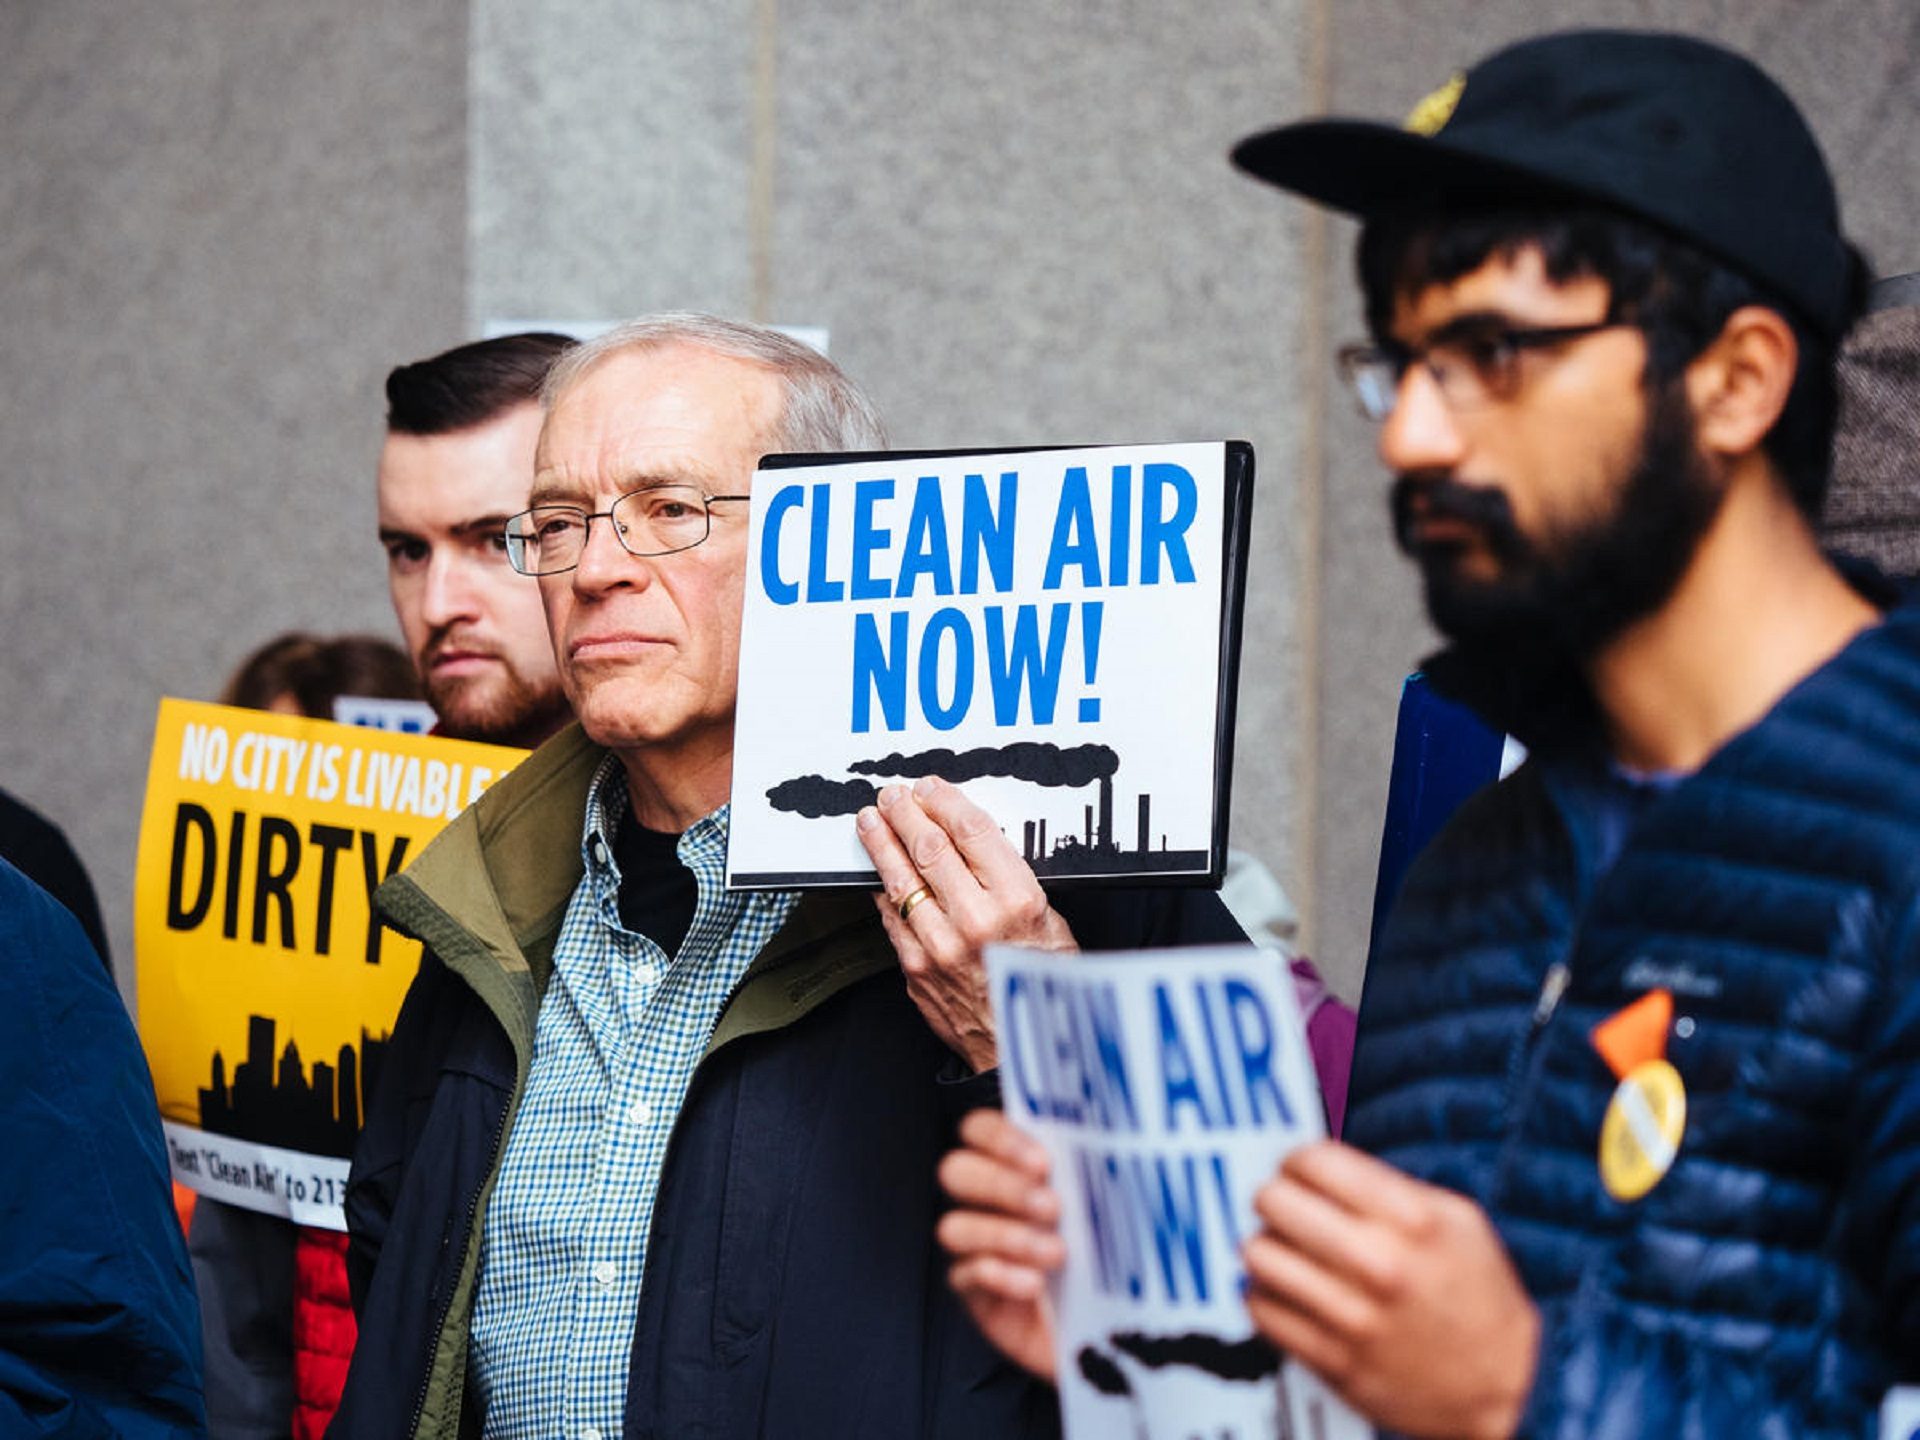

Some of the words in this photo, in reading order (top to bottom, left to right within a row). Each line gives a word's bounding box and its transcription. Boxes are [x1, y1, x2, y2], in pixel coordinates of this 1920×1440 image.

[760, 471, 1019, 606] CLEAN
[1042, 462, 1198, 590] AIR
[850, 601, 1104, 734] NOW!
[179, 722, 229, 785] NO
[231, 731, 308, 797] CITY
[306, 741, 343, 803] IS
[166, 800, 411, 966] DIRTY
[1153, 975, 1295, 1132] AIR
[286, 1174, 307, 1202] to
